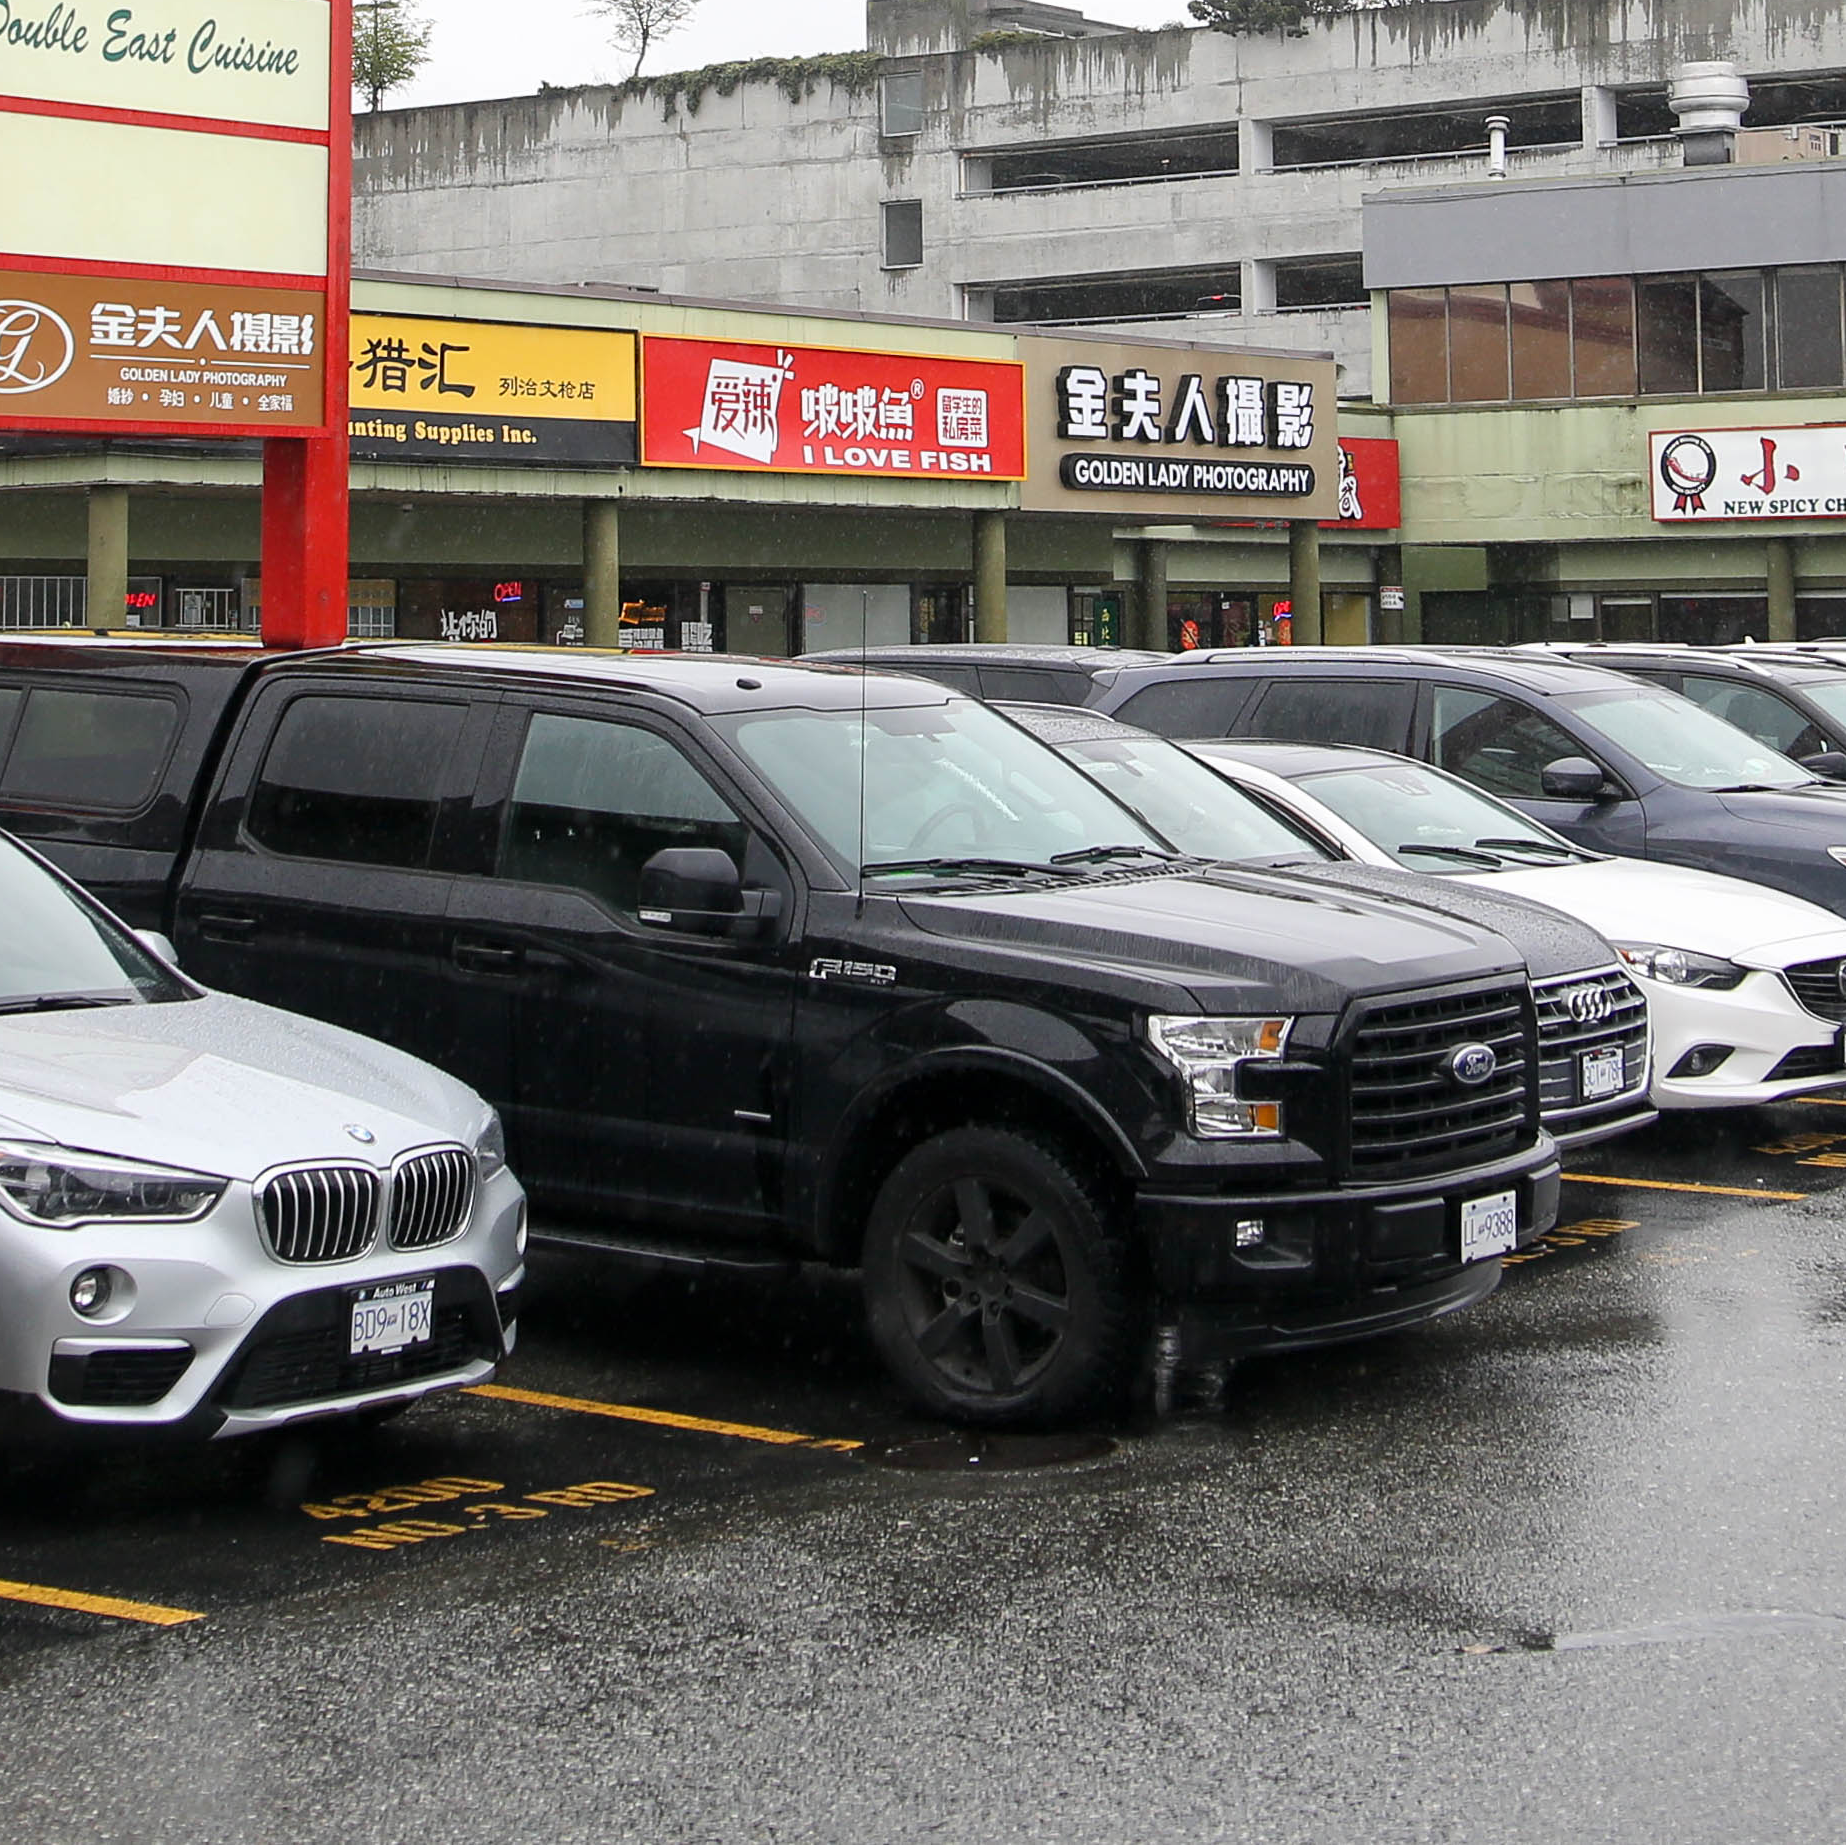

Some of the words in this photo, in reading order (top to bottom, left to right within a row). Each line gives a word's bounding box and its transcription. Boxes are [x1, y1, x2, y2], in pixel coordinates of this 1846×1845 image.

[103, 10, 176, 63] East
[188, 19, 299, 75] Cuisine
[120, 367, 168, 382] GOLDEN
[171, 369, 200, 383] LADY
[203, 372, 287, 387] PHOTOGRAPHY
[349, 337, 475, 398] 猎汇
[499, 377, 595, 400] 列治文枪店
[415, 421, 494, 445] Supplies
[502, 425, 537, 443] Inc.
[803, 446, 814, 465] I
[824, 447, 910, 469] LOVE
[921, 451, 991, 472] FISH
[1075, 460, 1144, 485] GOLDEN
[1148, 463, 1189, 488] LADY
[1194, 466, 1309, 492] PHOTOGRAPHY
[1724, 501, 1764, 515] NEW
[1770, 499, 1819, 514] SPICY
[494, 582, 522, 602] OPEN
[1466, 1053, 1489, 1075] Ford
[373, 1284, 394, 1299] Auto
[396, 1283, 416, 1295] West
